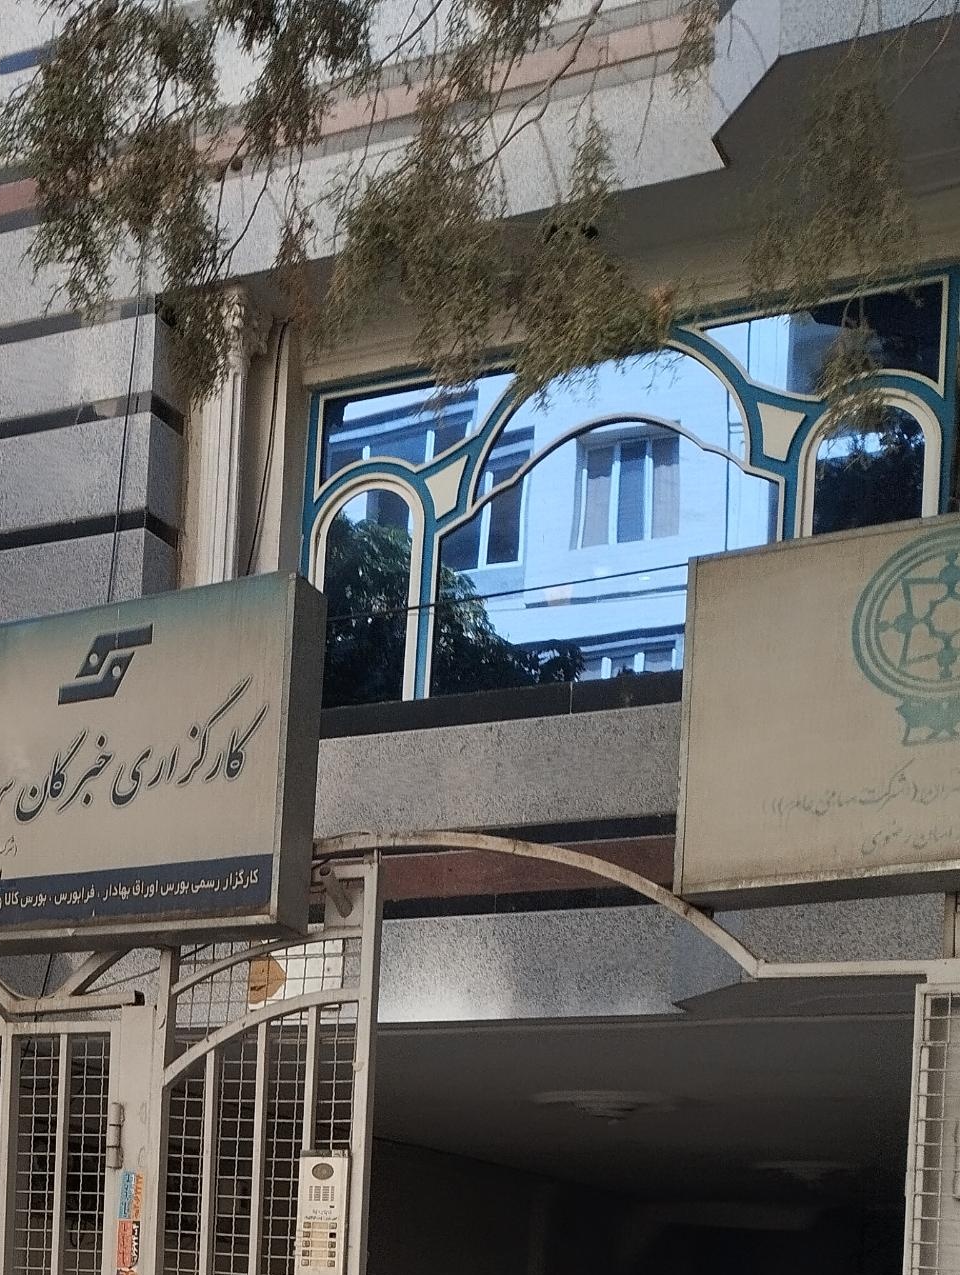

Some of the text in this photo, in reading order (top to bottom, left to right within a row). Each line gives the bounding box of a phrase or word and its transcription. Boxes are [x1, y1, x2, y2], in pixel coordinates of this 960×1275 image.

[111, 673, 269, 808] کارگزاری
[14, 727, 114, 824] خبرگان
[131, 879, 159, 899] اوراق
[159, 880, 190, 896] بورس
[190, 877, 220, 894] رسمی
[223, 869, 258, 890] کارگزار
[4, 890, 20, 906] کالا
[20, 892, 47, 908] بورس
[54, 883, 96, 906] فرابورس
[102, 881, 131, 901] بهادار
